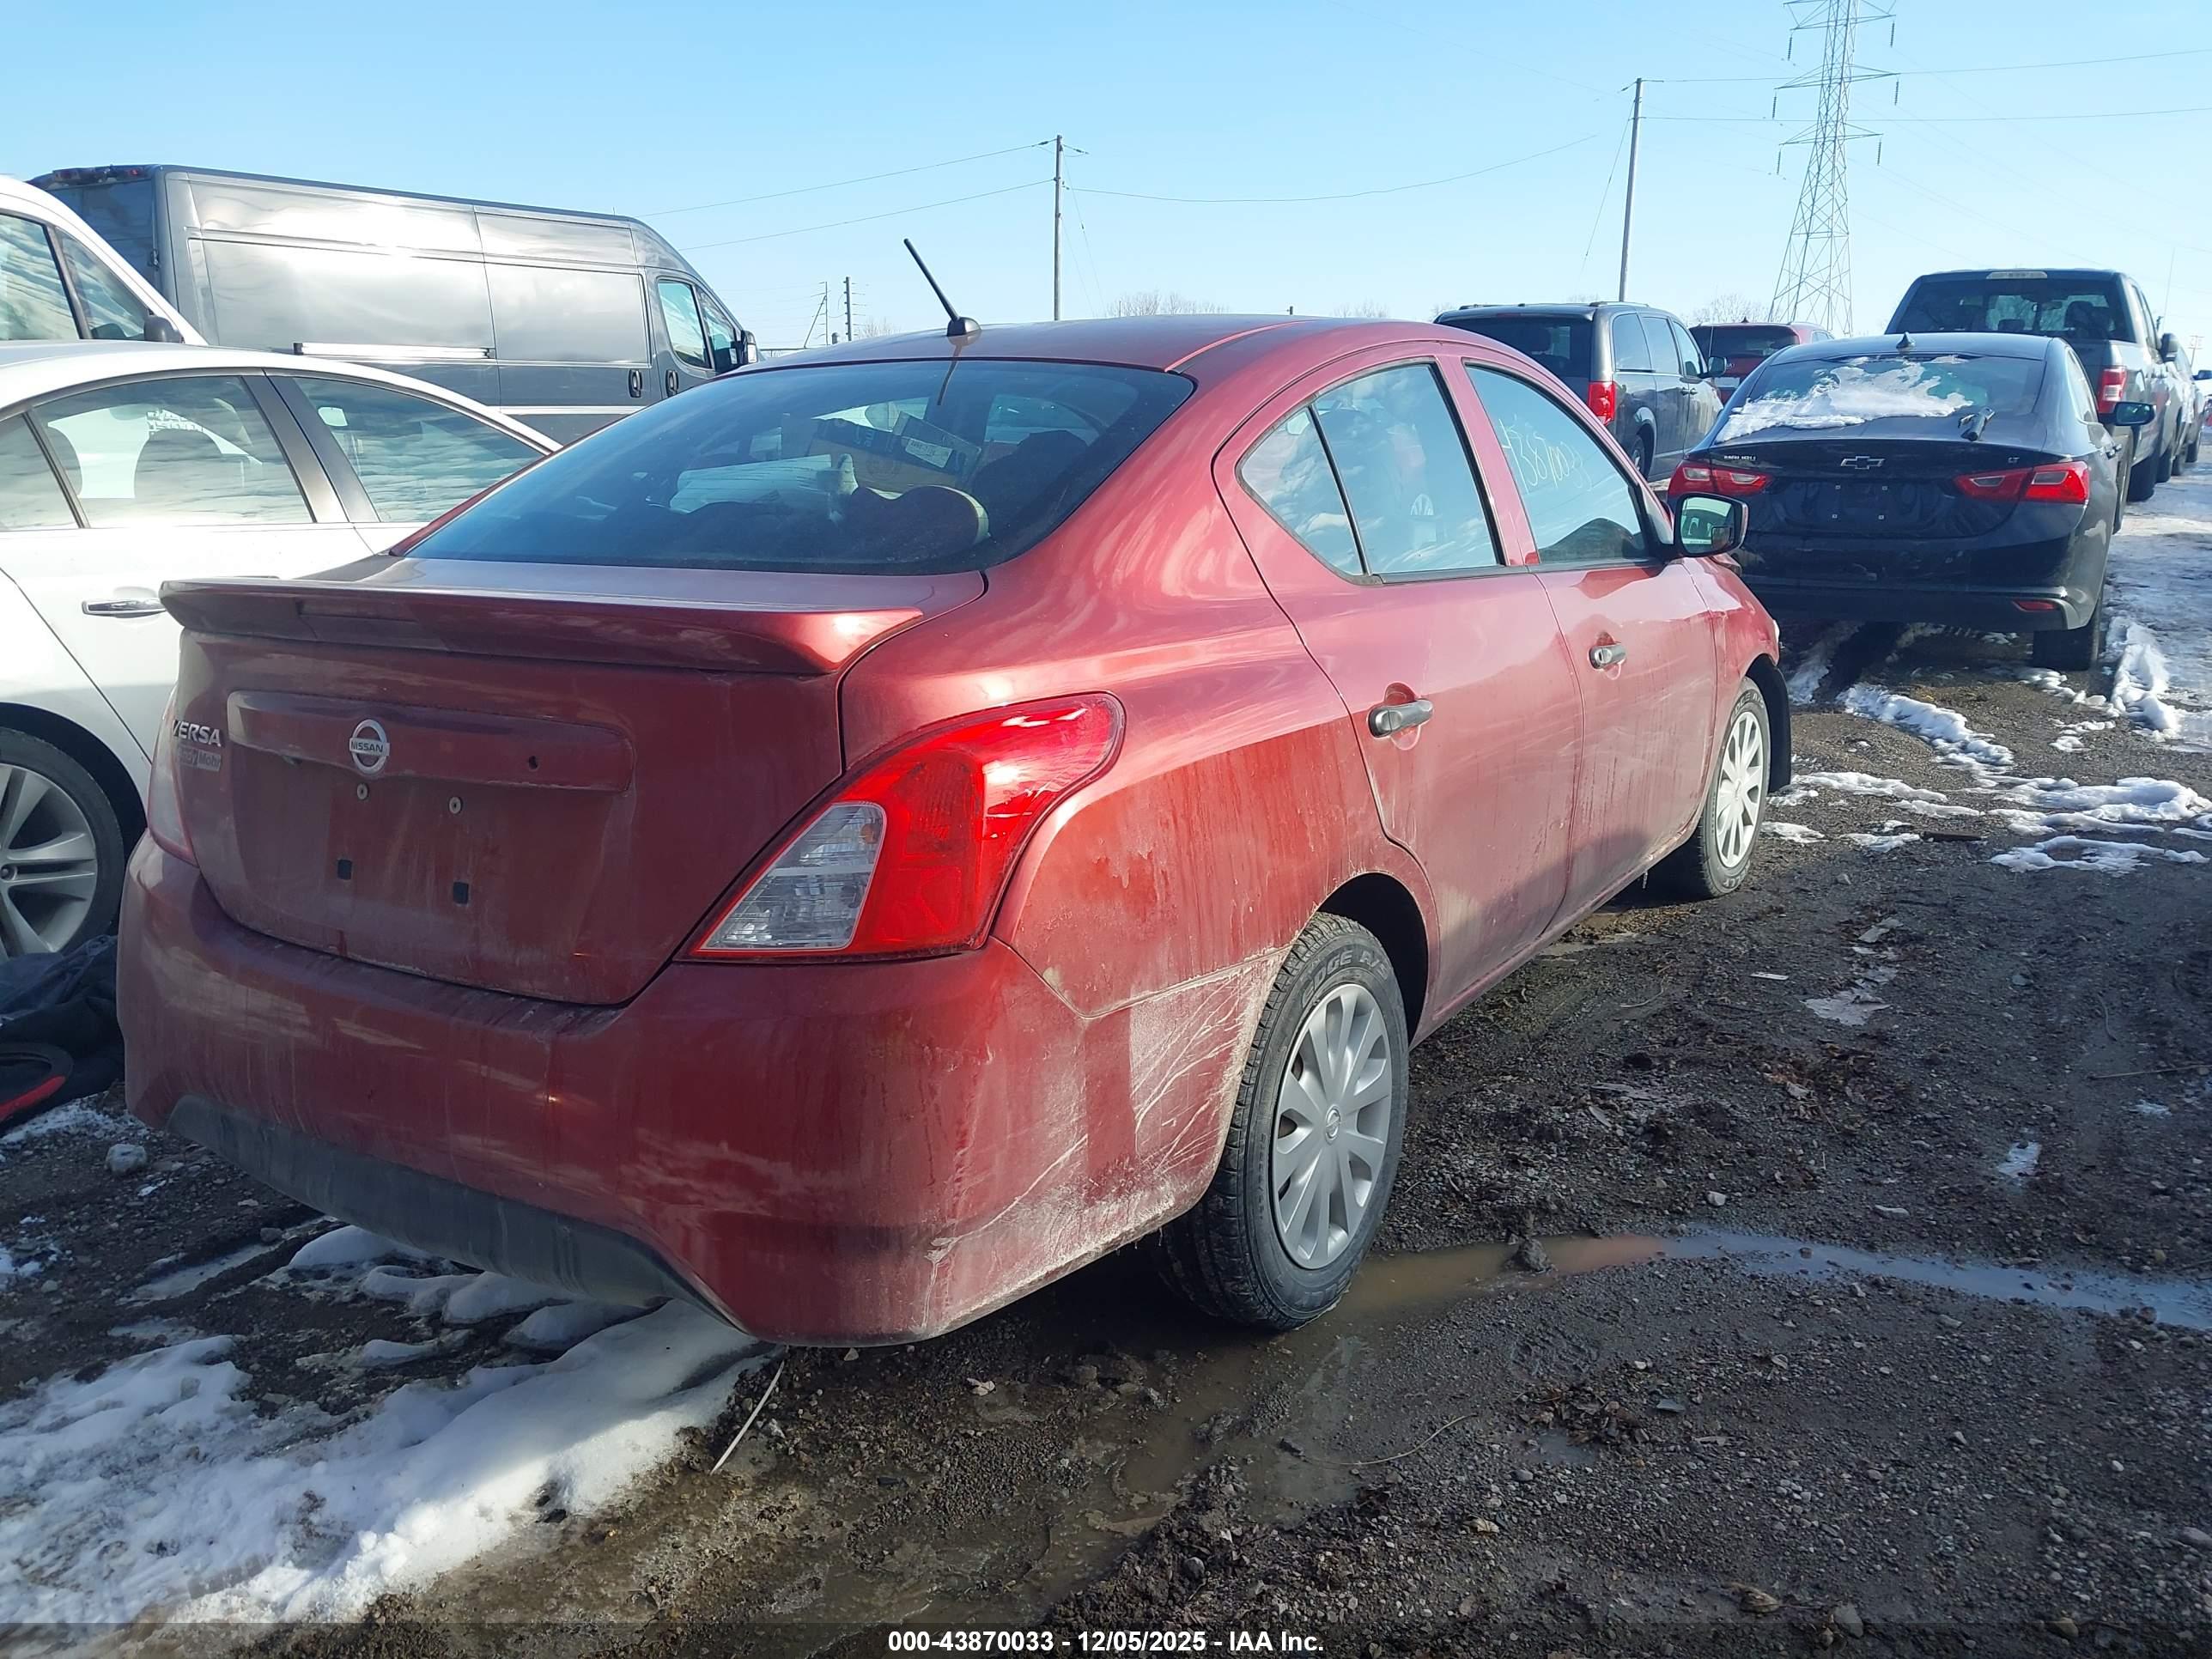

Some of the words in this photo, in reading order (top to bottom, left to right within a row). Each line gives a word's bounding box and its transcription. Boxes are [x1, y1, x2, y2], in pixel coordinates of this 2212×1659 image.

[172, 720, 222, 747] VERSA
[350, 740, 384, 753] NISSAN
[1302, 950, 1353, 1009] EDGE
